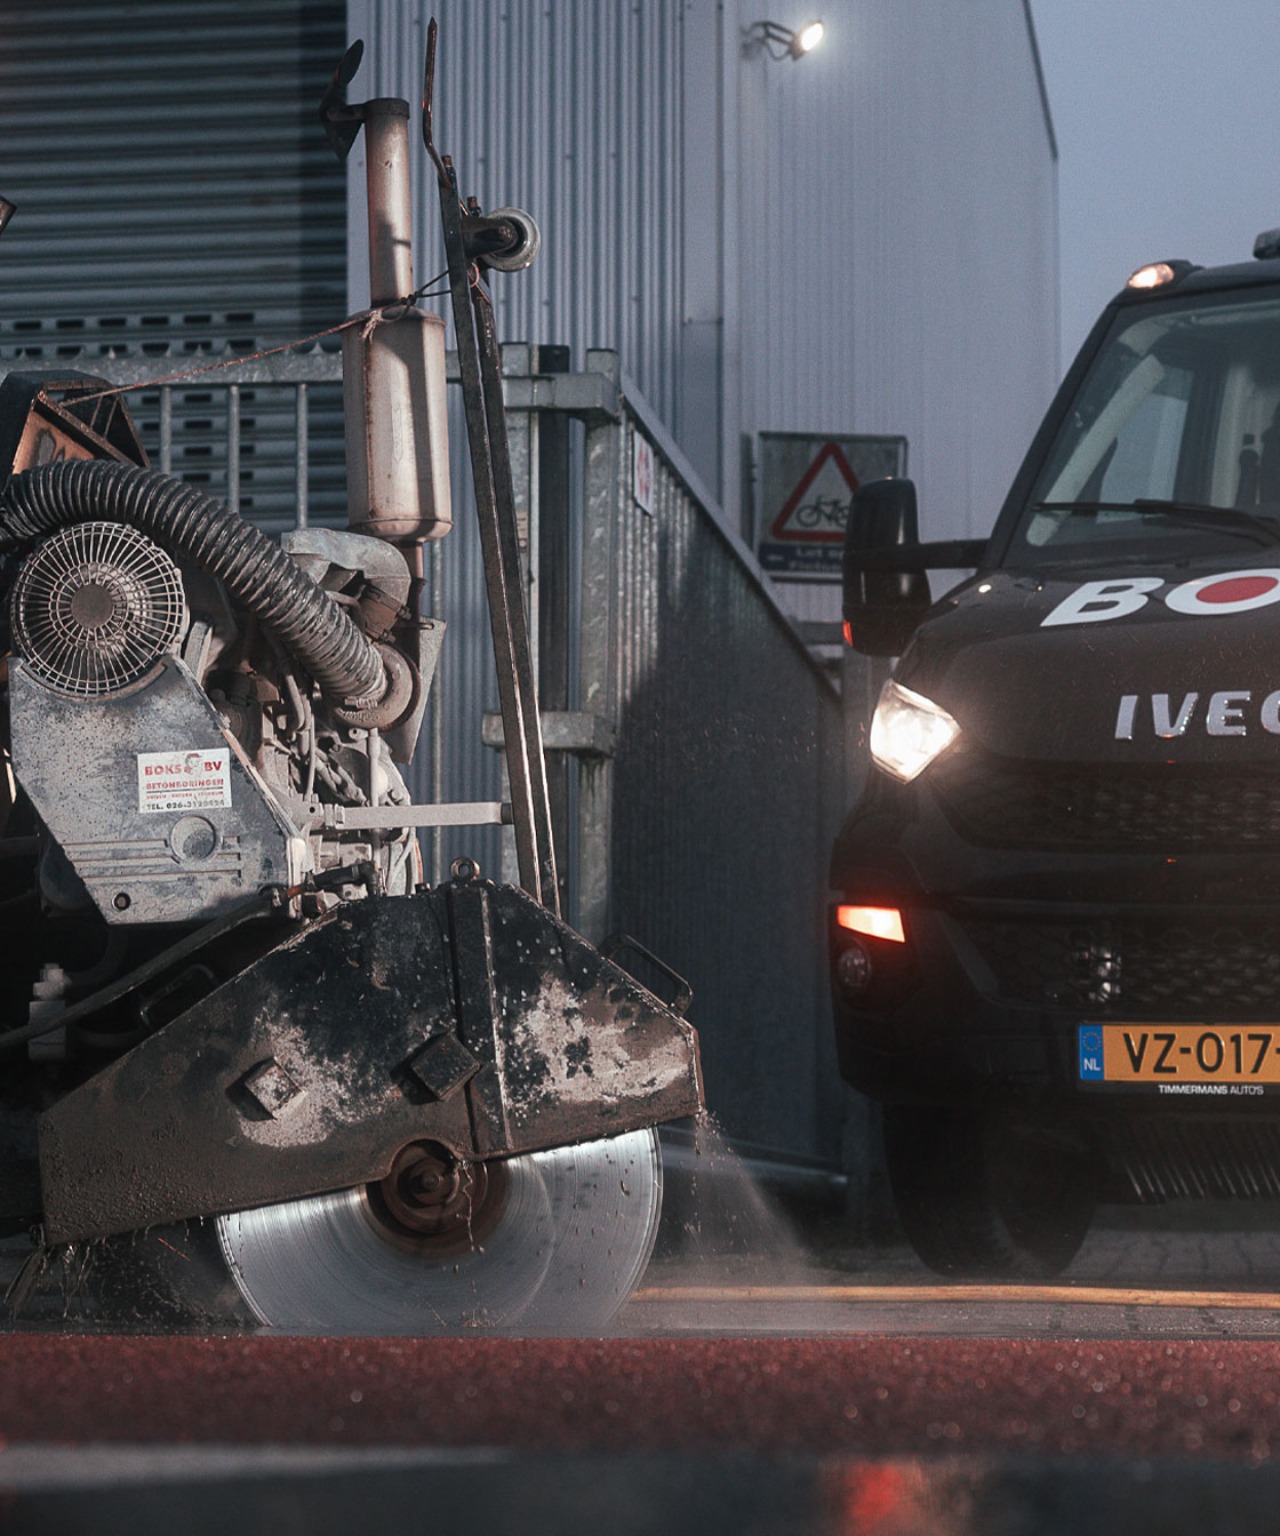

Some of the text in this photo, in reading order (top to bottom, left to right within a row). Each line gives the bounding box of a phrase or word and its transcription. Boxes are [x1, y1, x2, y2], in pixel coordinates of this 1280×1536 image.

[144, 761, 222, 776] BOKS BV
[146, 802, 164, 811] TEL.
[1083, 1058, 1101, 1072] NL
[1158, 1083, 1265, 1096] TIMMERMANS AUTO'S
